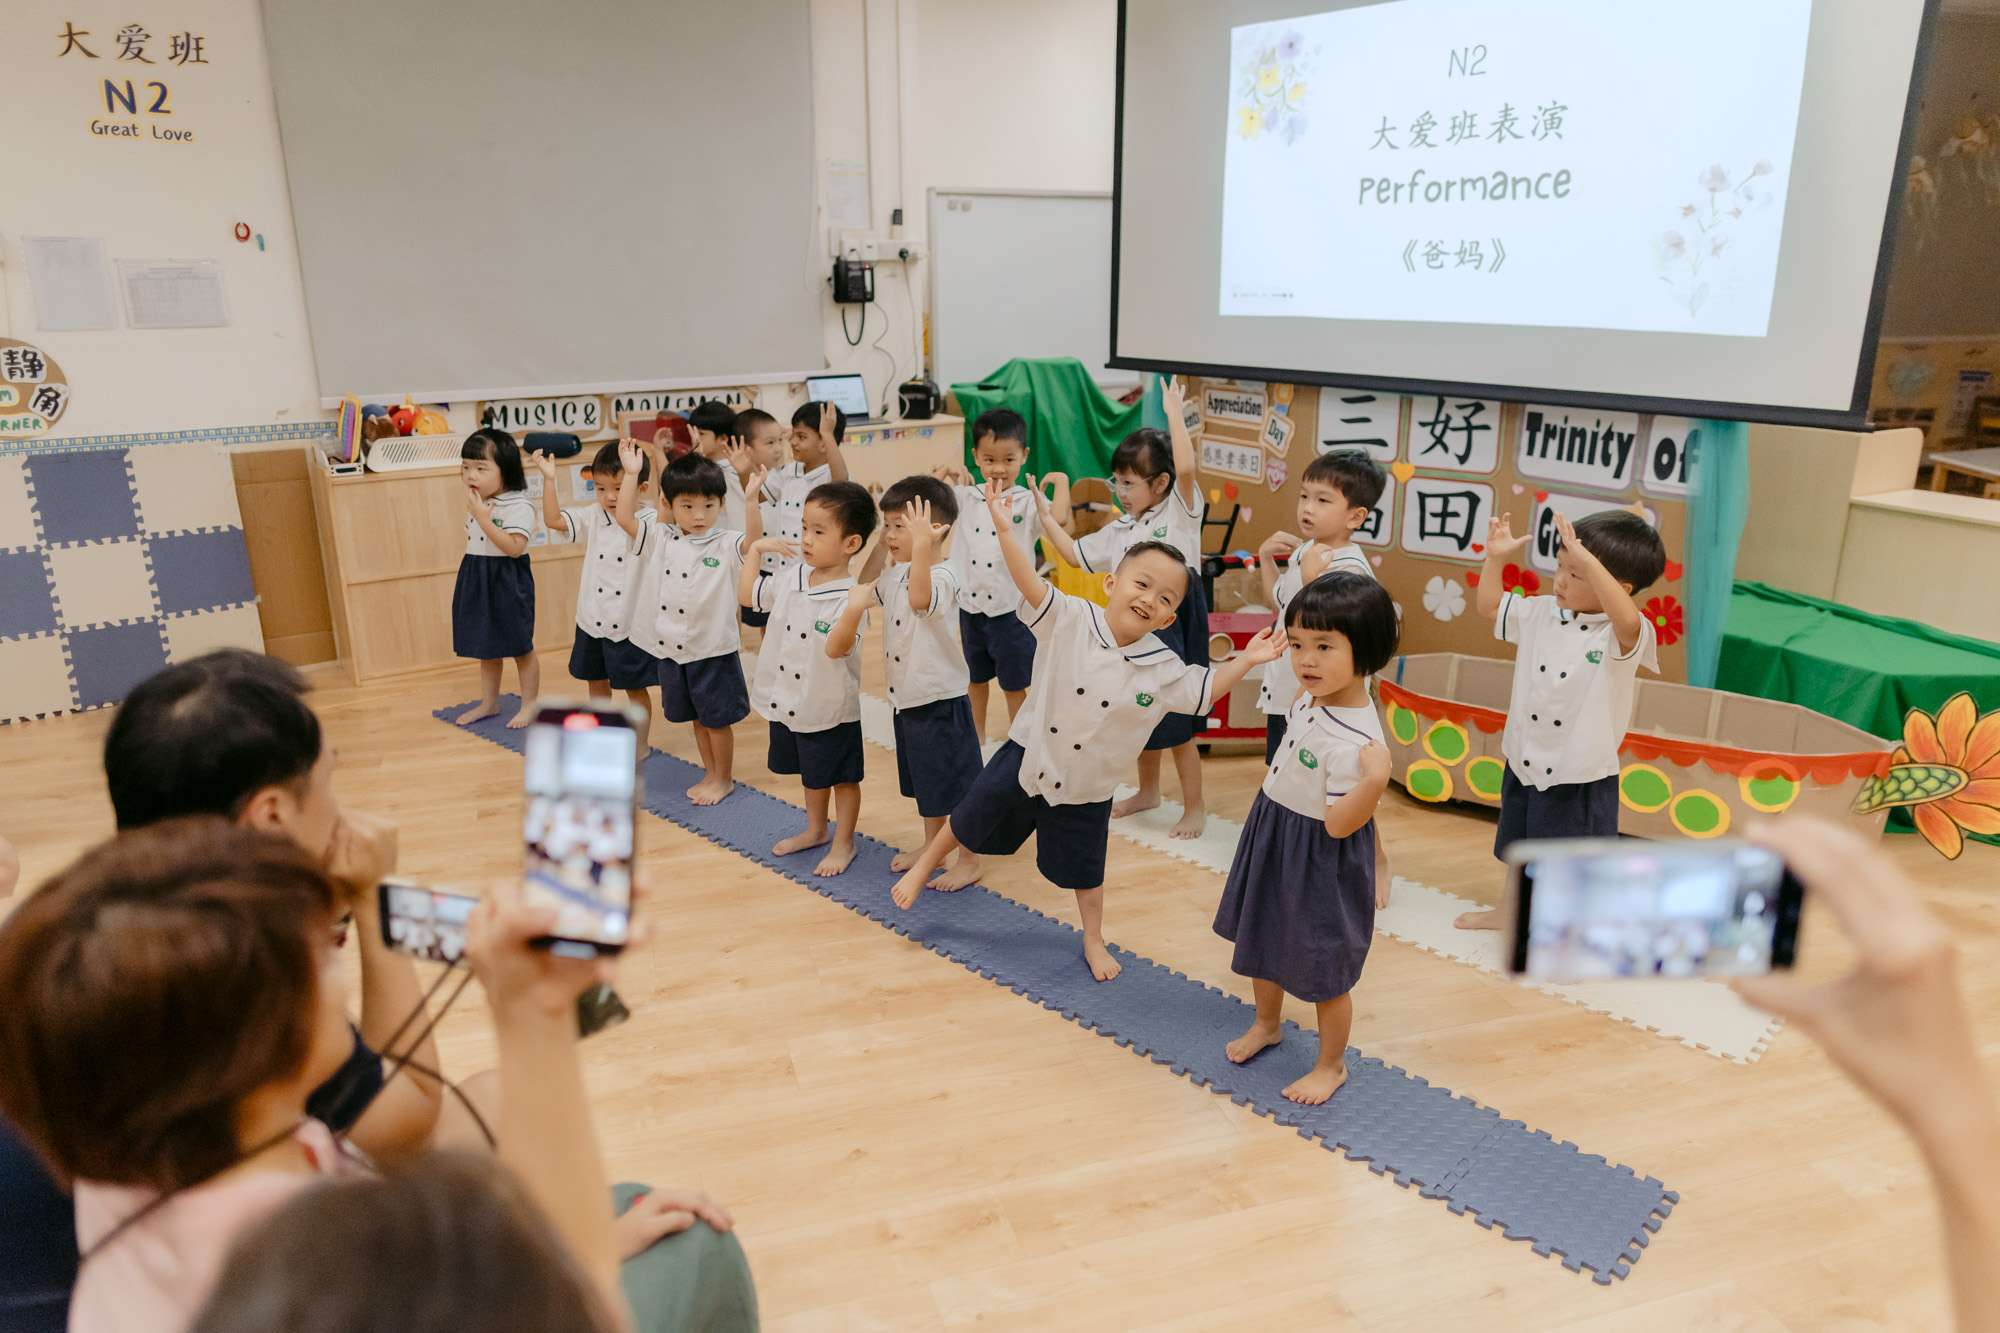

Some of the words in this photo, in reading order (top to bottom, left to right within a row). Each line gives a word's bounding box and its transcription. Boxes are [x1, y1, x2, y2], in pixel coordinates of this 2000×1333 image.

[58, 21, 209, 66] 大爱班
[1448, 44, 1489, 78] N2
[91, 120, 140, 137] Great
[152, 125, 193, 142] Love
[1369, 100, 1569, 151] 大爱班表演
[1208, 392, 1262, 416] Appreciation
[1268, 419, 1286, 446] Day
[1526, 411, 1635, 479] Trinity
